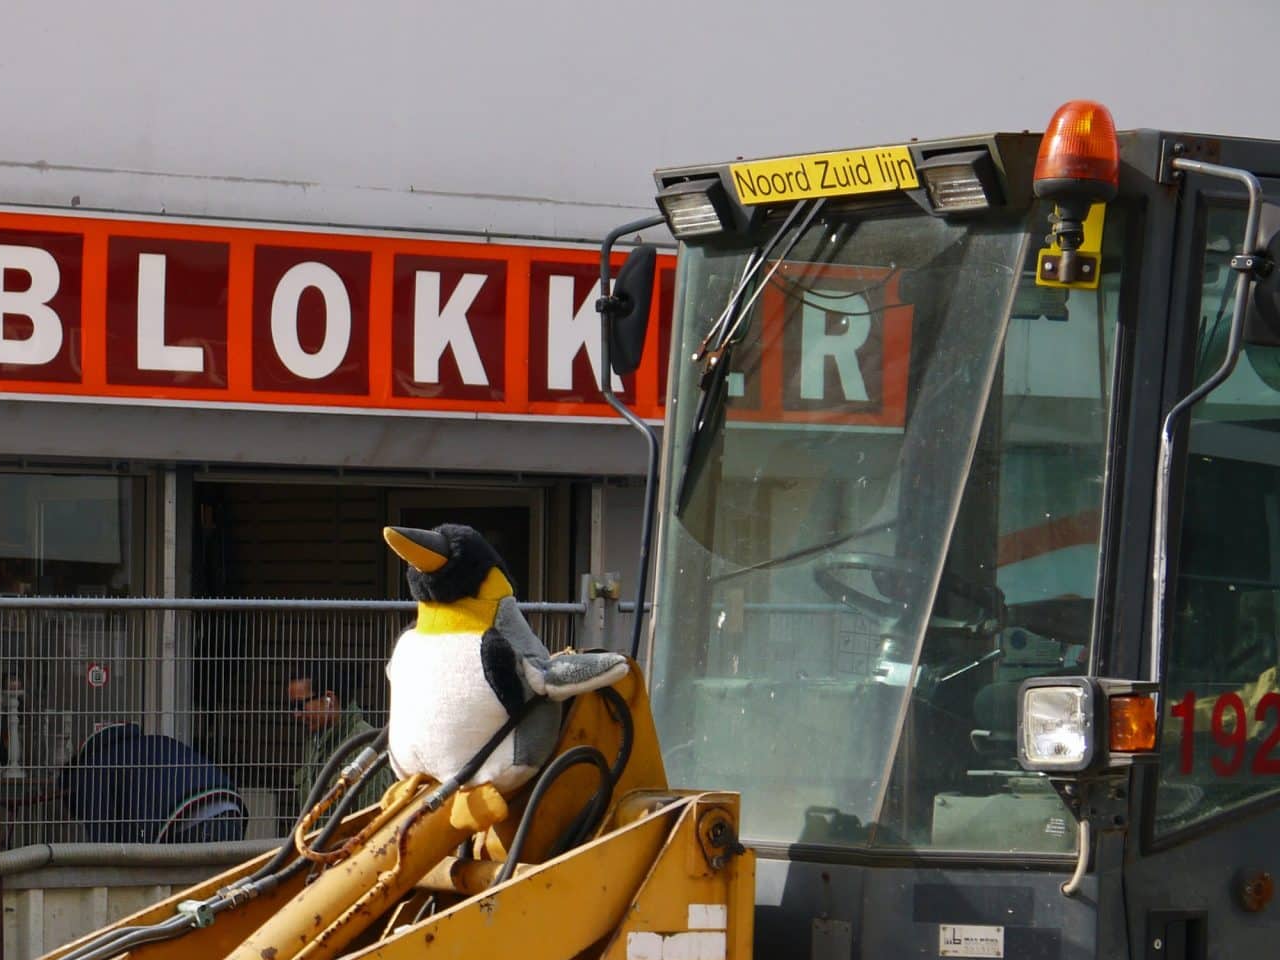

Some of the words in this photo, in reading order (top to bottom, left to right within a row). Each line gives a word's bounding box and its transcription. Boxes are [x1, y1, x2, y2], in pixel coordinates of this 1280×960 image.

[734, 163, 812, 198] Noord
[814, 155, 873, 190] Zuid
[875, 152, 915, 190] lijn
[1170, 689, 1280, 777] 192
